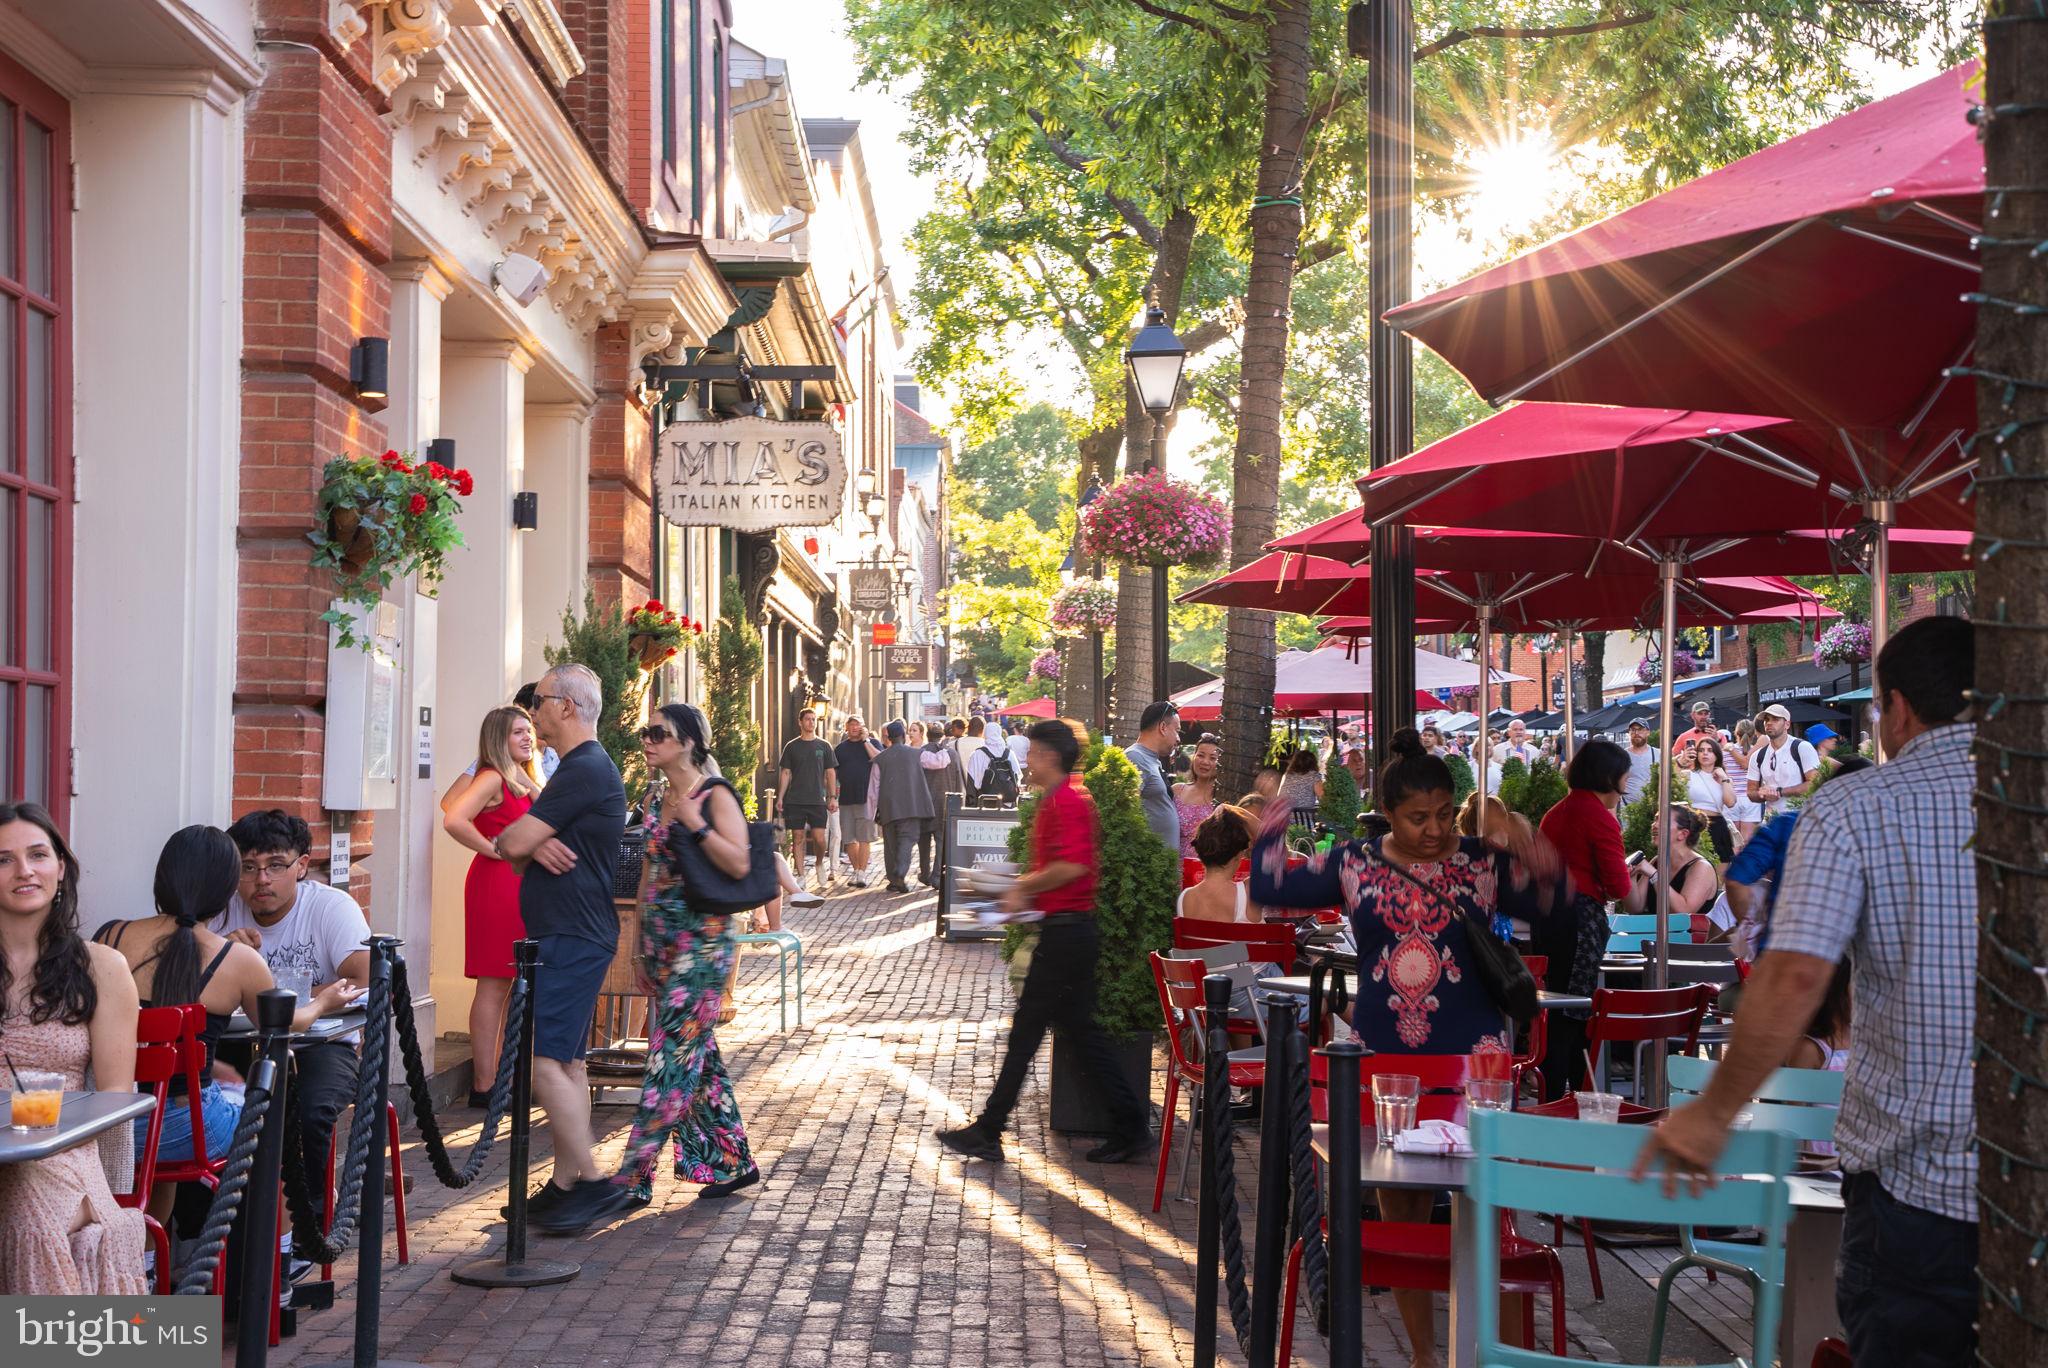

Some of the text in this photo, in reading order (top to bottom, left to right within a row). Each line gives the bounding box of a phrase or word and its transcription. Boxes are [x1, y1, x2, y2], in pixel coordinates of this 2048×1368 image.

[671, 439, 829, 486] MIA'S
[671, 493, 829, 510] ITALIAN KITCHEN
[893, 648, 920, 656] PAPER
[890, 656, 923, 664] SOURCE
[973, 853, 1009, 865] NOW
